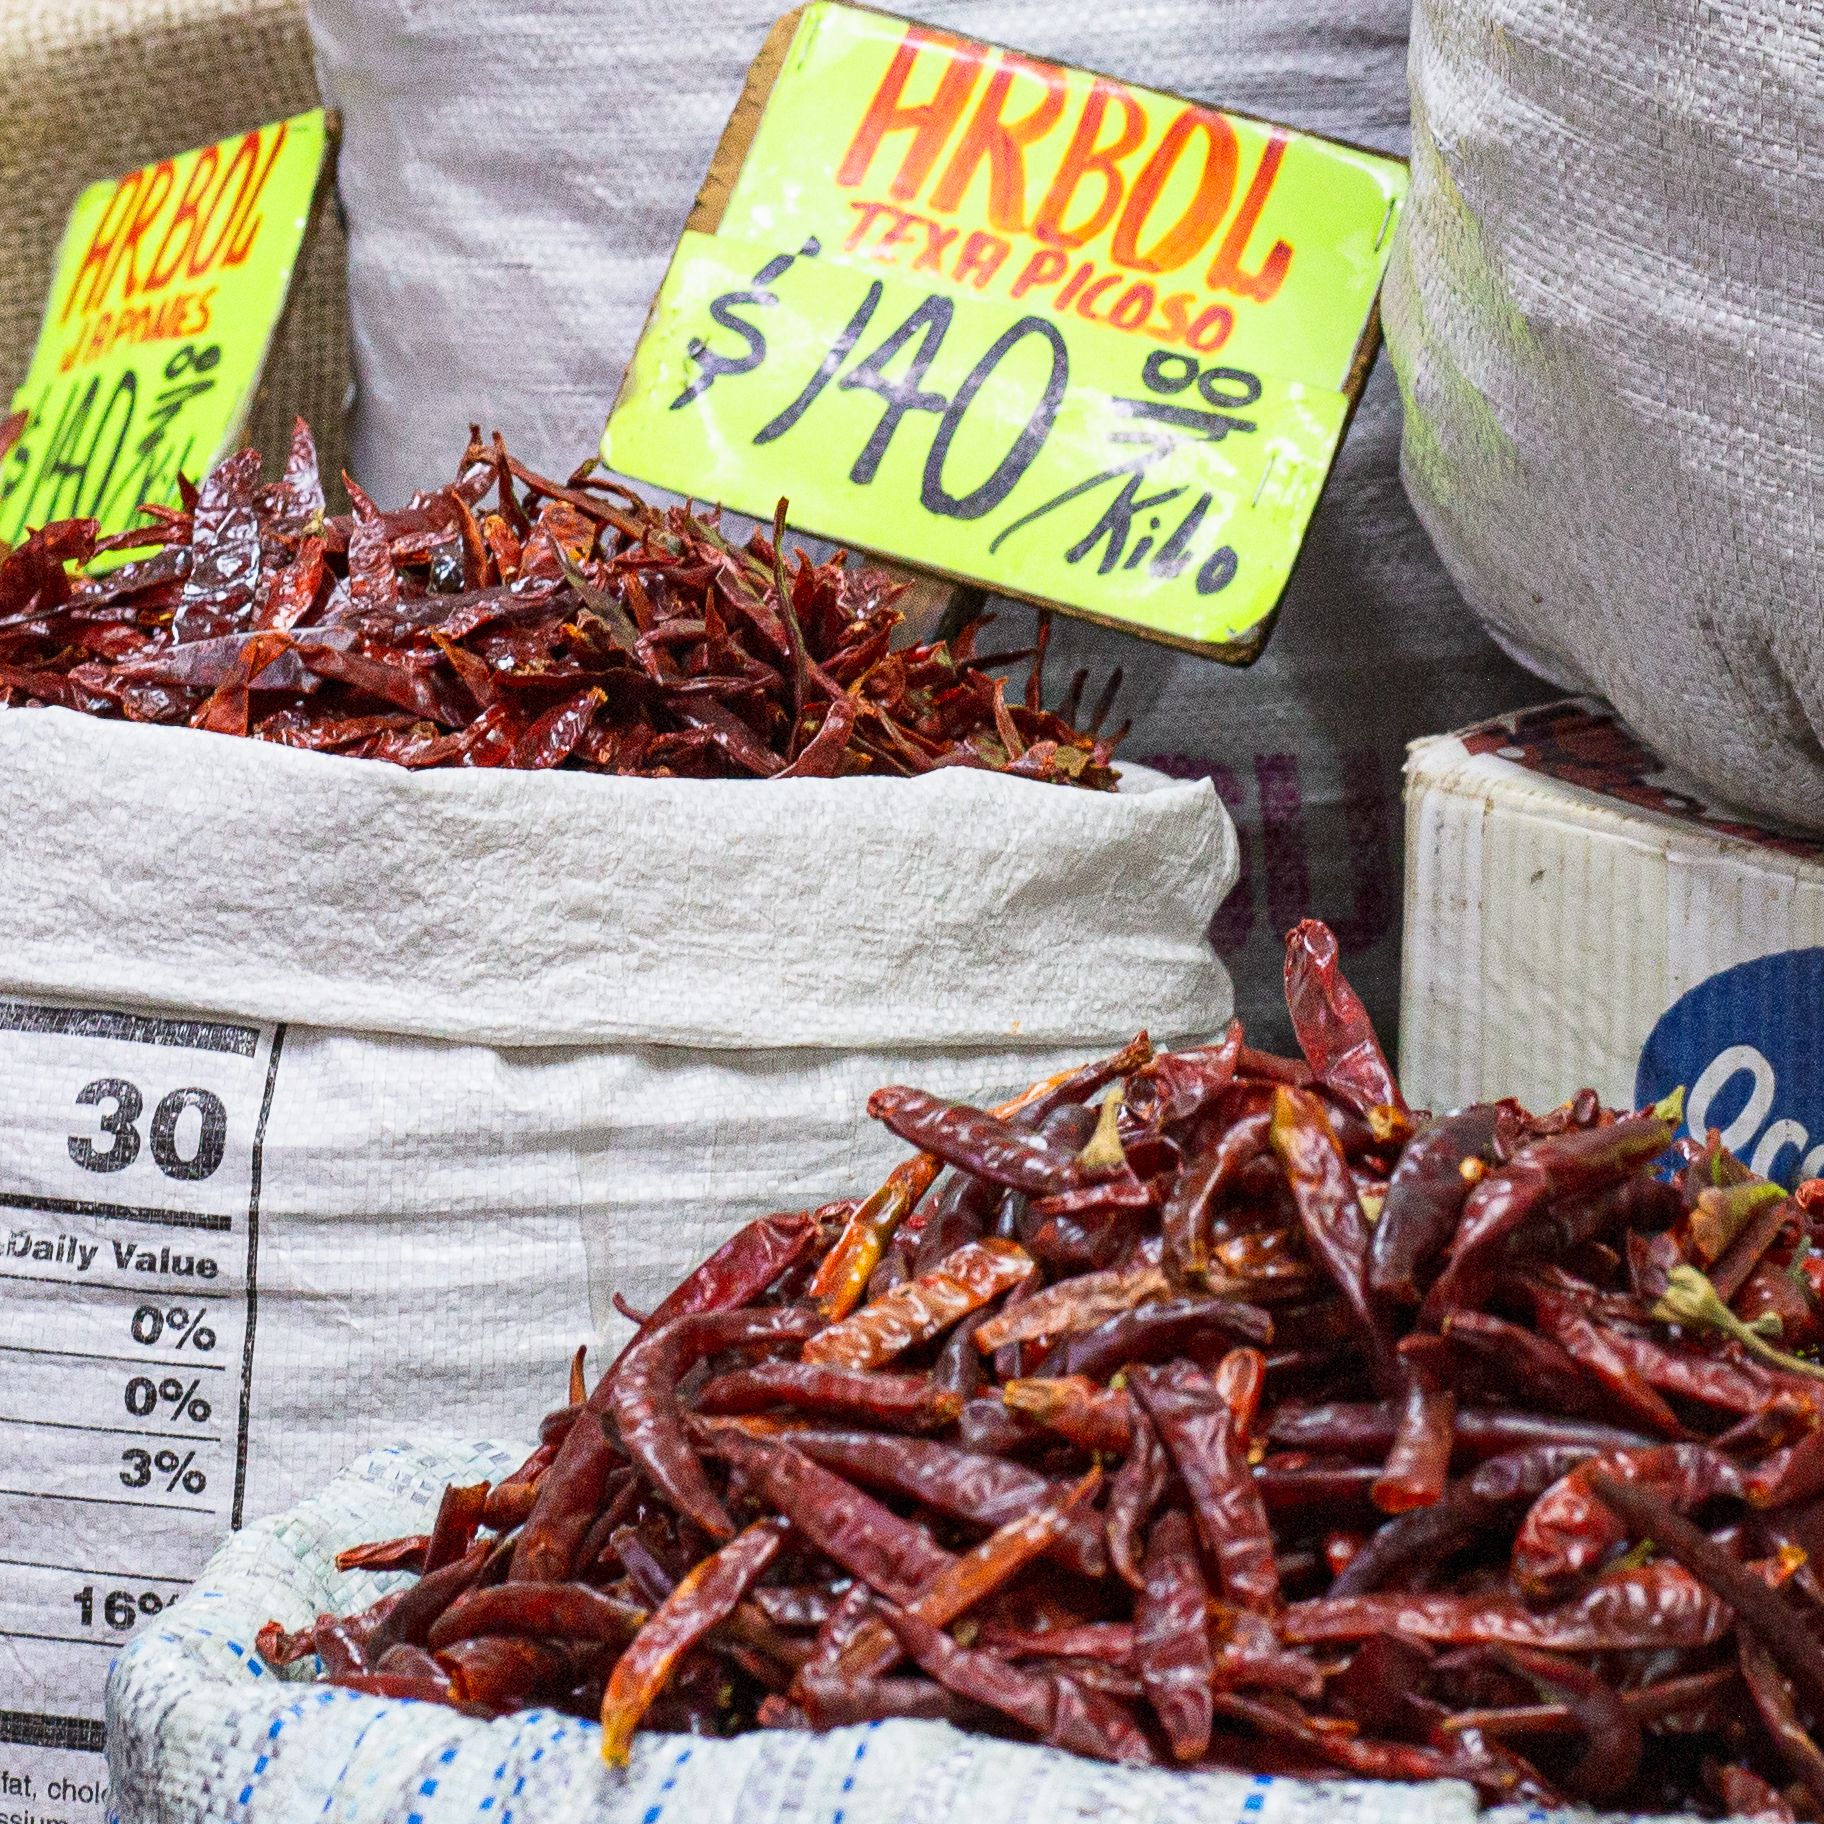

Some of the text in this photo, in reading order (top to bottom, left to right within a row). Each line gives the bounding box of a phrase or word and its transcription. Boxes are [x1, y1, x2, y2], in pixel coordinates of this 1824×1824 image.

[844, 200, 1235, 354] TEXA PICOSO
[669, 235, 1069, 520] $140
[66, 1077, 228, 1182] 30
[112, 1239, 218, 1279] Value
[130, 1304, 216, 1352] 0%
[124, 1376, 212, 1423] 0%
[119, 1448, 207, 1495] 3%
[1, 1771, 37, 1800] fat,
